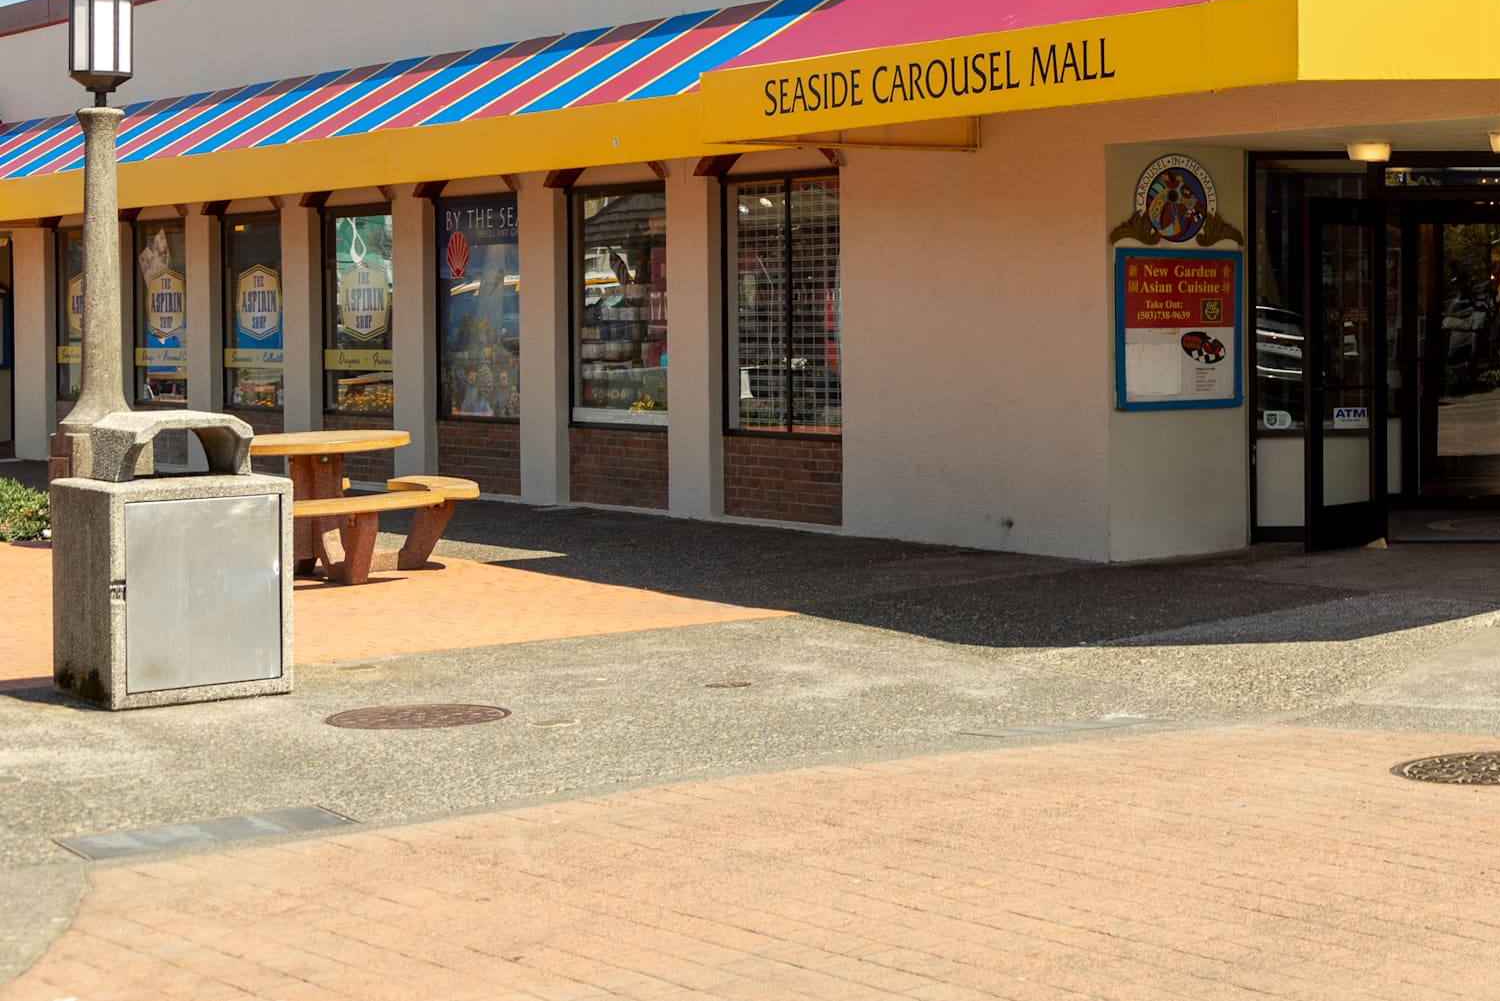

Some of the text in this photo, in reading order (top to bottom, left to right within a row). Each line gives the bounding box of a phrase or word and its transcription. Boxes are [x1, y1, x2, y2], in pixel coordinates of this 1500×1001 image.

[765, 38, 1115, 116] SEASIDE CAROUSEL MALL
[1138, 157, 1215, 206] CAROUSEL IN THE MALL
[446, 207, 519, 231] BY THE SE
[1144, 264, 1217, 277] New Garden
[161, 279, 171, 289] THE
[254, 275, 264, 287] THE
[358, 272, 370, 284] THE
[1141, 280, 1220, 293] Asian Cuisine
[151, 293, 182, 313] ASPIRIN
[242, 290, 276, 312] ASPIRIN
[344, 288, 384, 311] ASPIRIN
[1145, 300, 1183, 309] Take Out:
[356, 315, 372, 329] SHOP
[1137, 311, 1190, 320] (503)738-9639
[160, 317, 173, 328] SHOP
[252, 316, 266, 329] SHOP
[1336, 409, 1366, 418] ATM
